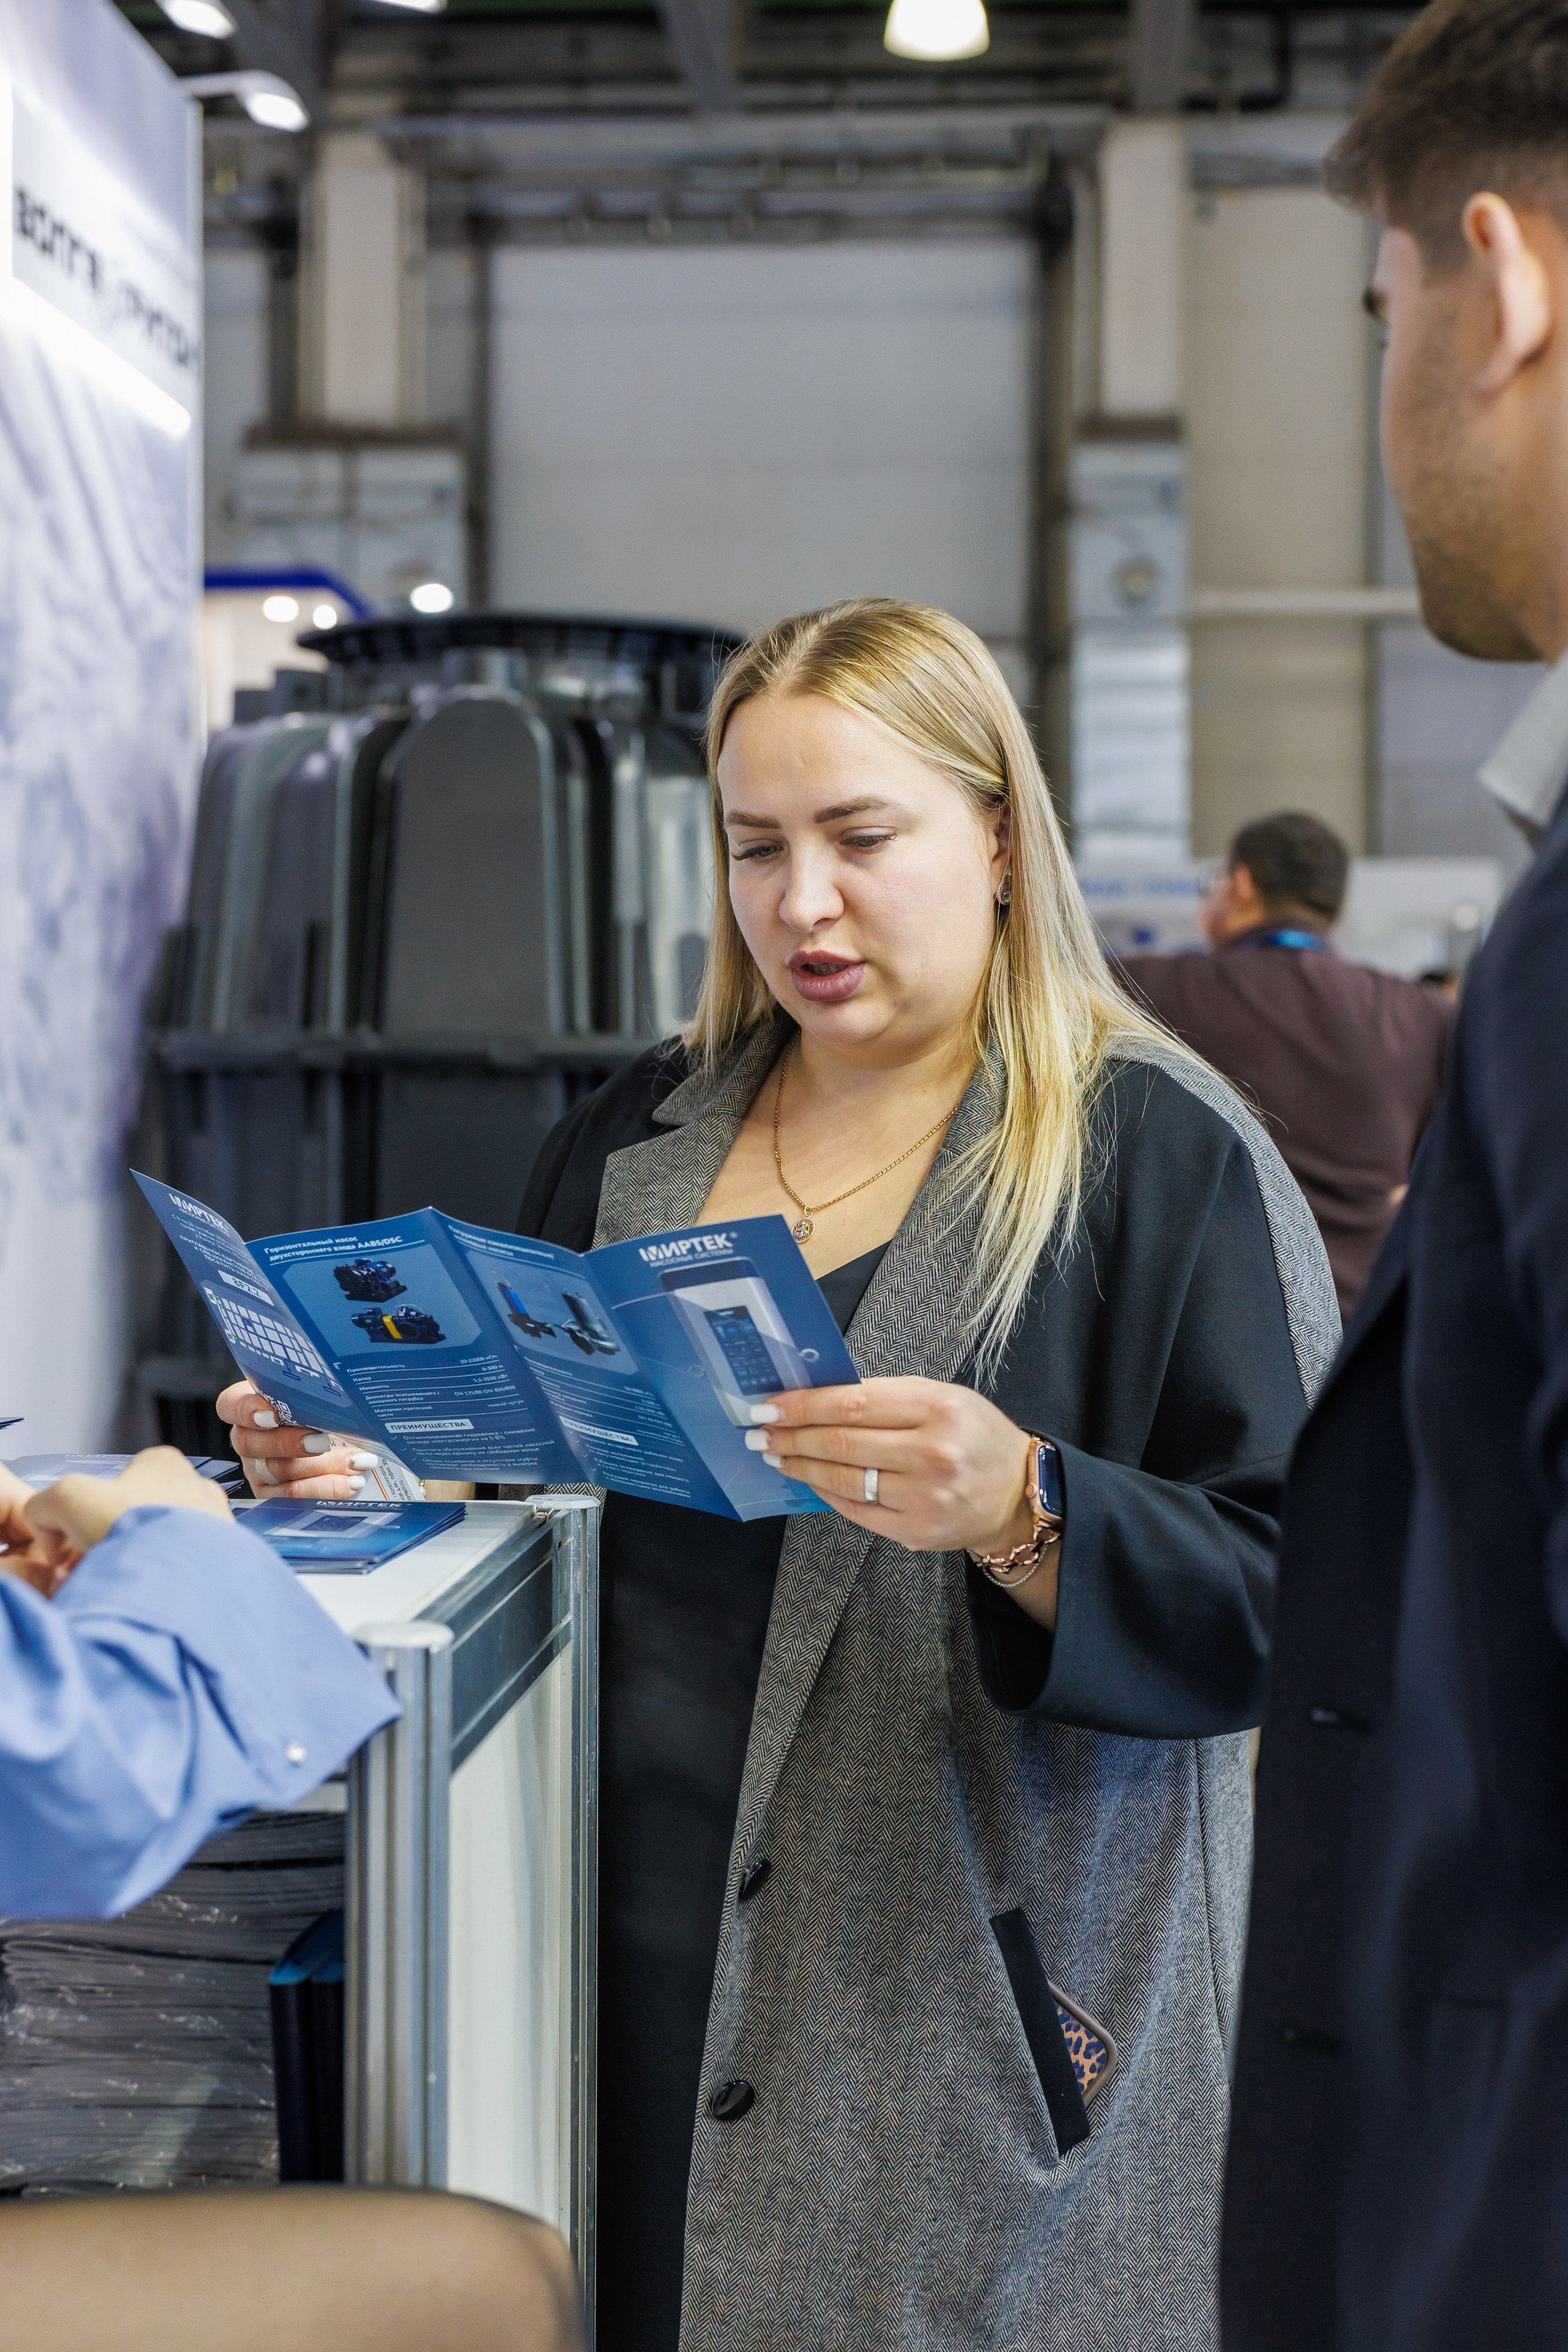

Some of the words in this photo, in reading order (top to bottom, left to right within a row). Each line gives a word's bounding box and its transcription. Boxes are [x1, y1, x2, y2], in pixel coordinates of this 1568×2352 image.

[179, 1235, 222, 1257] ПРИГЛАШАЕМ
[264, 1238, 334, 1254] Горизонтальный
[270, 1247, 333, 1262] двухстороннего
[358, 1235, 404, 1251] AABS/DSC
[638, 1232, 734, 1262] МИРТЕК
[200, 1249, 247, 1273] СПЕЦИАЛИСТОВ
[649, 1254, 693, 1268] НАСОСНЫЕ
[694, 1247, 734, 1260] СИСТЕМЫ
[204, 1254, 236, 1273] ПОСЕТИТЬ
[236, 1270, 251, 1281] НАШ
[346, 1364, 405, 1373] Производительность
[464, 1387, 494, 1396] 125/80-DN
[579, 1434, 606, 1445] Широкий
[607, 1443, 643, 1452] ассортимент
[585, 1444, 609, 1453] Наличие
[610, 1451, 644, 1461] исполнений
[386, 1466, 396, 1480] офис
[594, 1457, 619, 1468] Рубашка
[619, 1464, 654, 1474] охлаждения
[665, 1474, 690, 1483] мокрого
[640, 1461, 676, 1472] устройством
[602, 1471, 629, 1481] Режущий
[630, 1479, 658, 1487] механизм
[610, 1477, 651, 1490] волокнистыми
[651, 1487, 691, 1498] включениями
